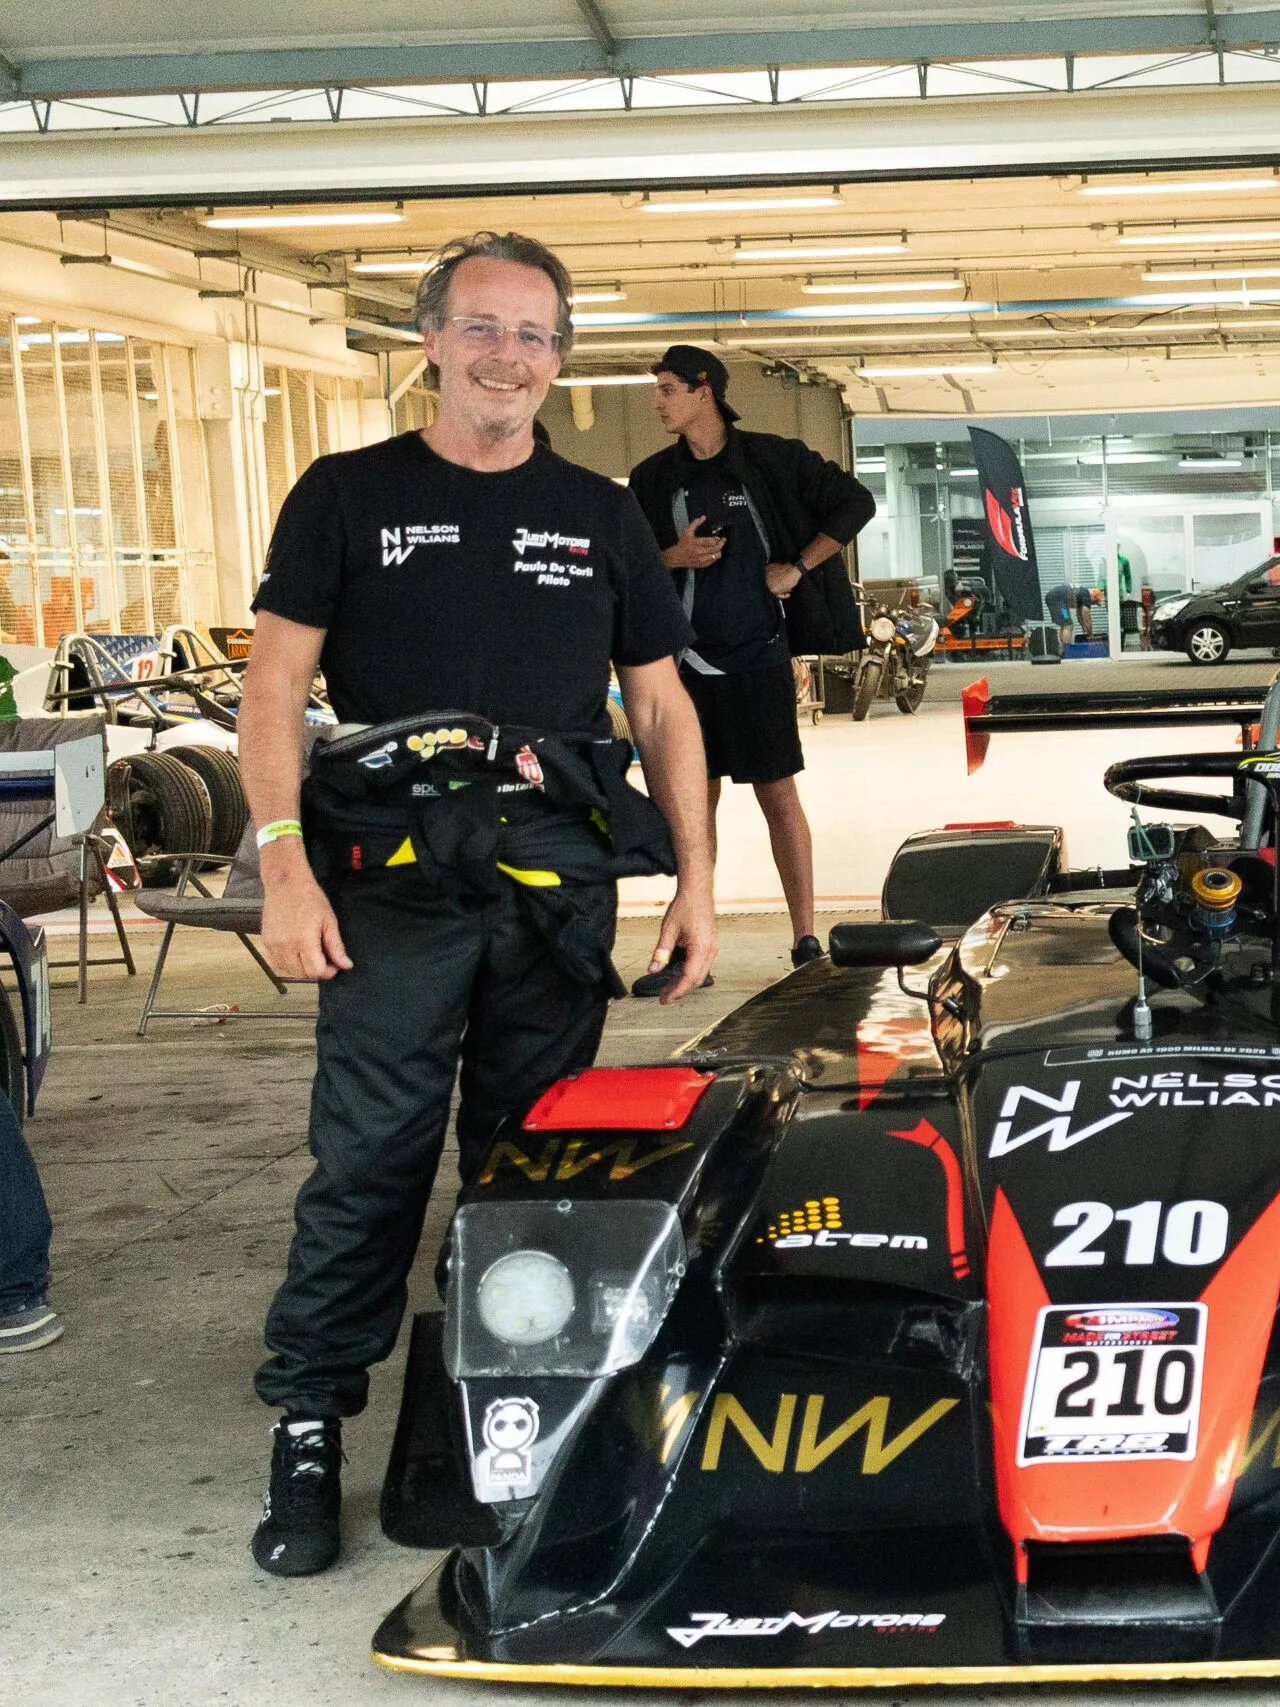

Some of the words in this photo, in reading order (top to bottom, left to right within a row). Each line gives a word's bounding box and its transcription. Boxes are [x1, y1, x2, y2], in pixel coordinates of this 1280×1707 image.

[406, 525, 459, 534] NELSON
[407, 534, 460, 544] WILIANS
[514, 561, 547, 572] Paulo
[537, 574, 570, 586] Piloto
[137, 659, 154, 681] 12
[774, 1229, 928, 1250] atem
[1044, 1200, 1229, 1267] 210
[1054, 1349, 1195, 1418] 210
[701, 1393, 961, 1475] NW
